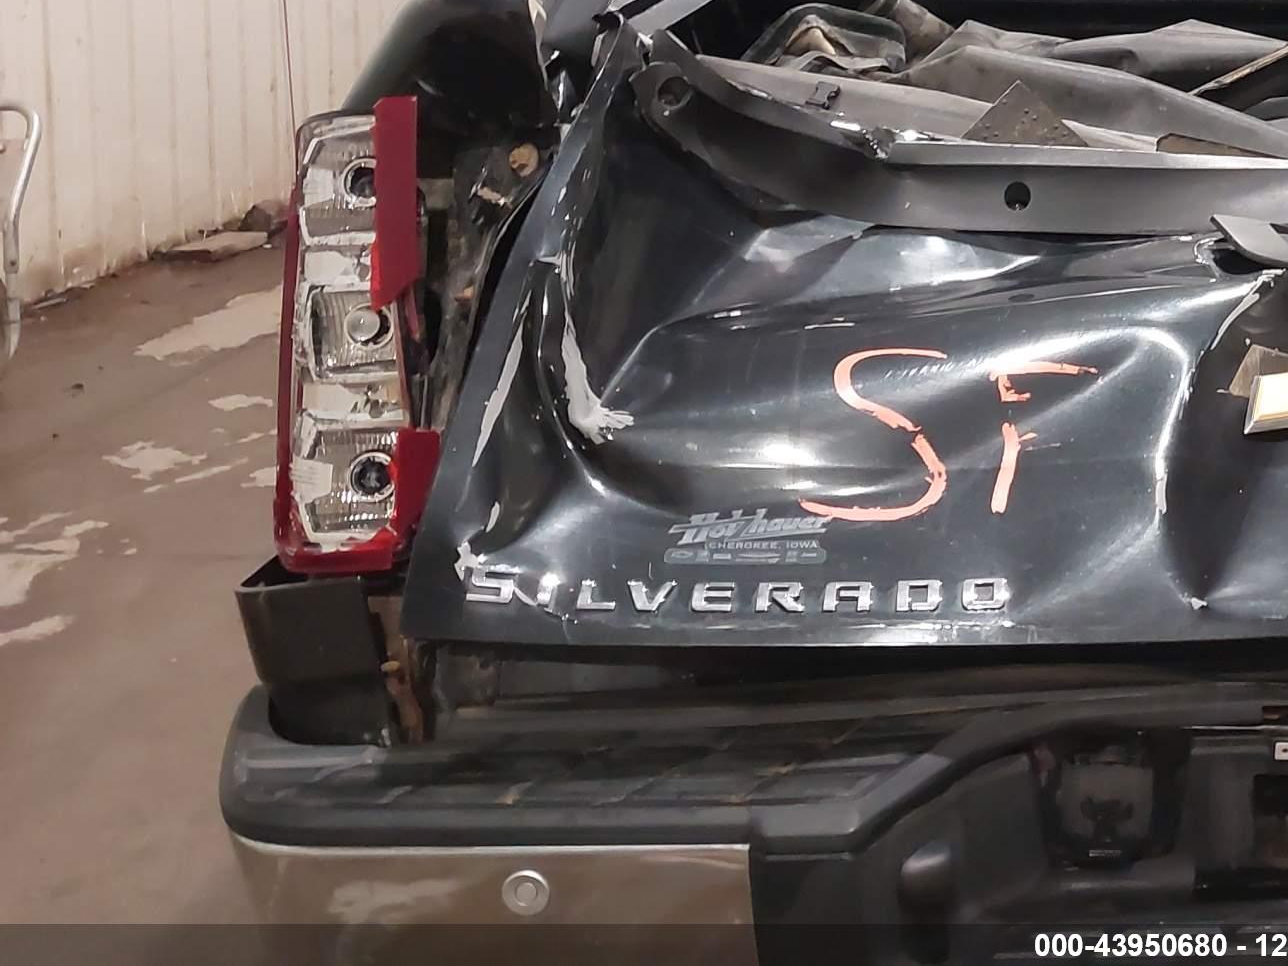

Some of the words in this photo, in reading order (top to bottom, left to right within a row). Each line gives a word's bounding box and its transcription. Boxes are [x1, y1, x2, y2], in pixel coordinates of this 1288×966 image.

[708, 540, 782, 550] CHEROKEE,
[786, 539, 819, 549] IOWA
[466, 569, 1010, 613] SILVERADO
